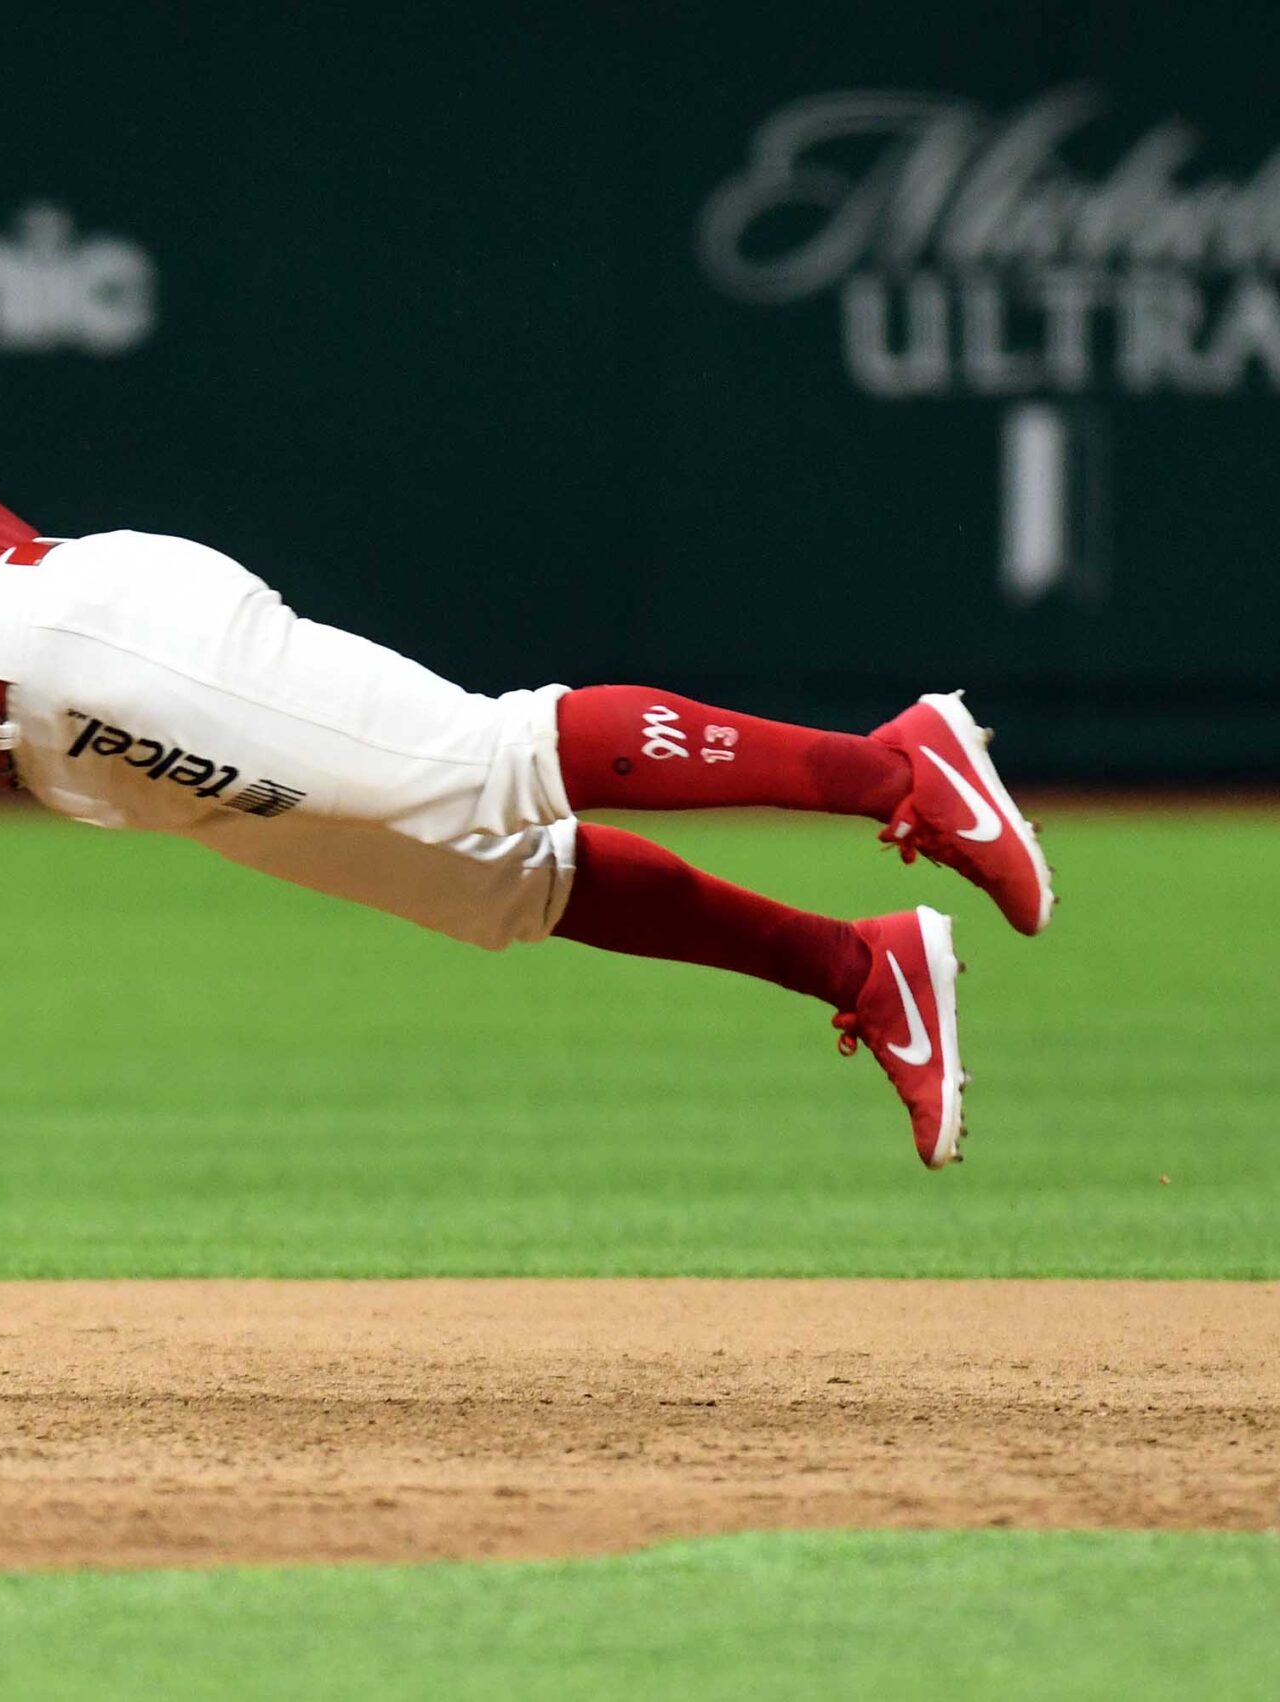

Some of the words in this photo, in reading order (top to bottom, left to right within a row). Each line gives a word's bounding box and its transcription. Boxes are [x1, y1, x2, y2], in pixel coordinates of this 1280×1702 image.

[842, 272, 1280, 400] ULTRA
[66, 718, 239, 798] telcel
[700, 724, 739, 763] 13
